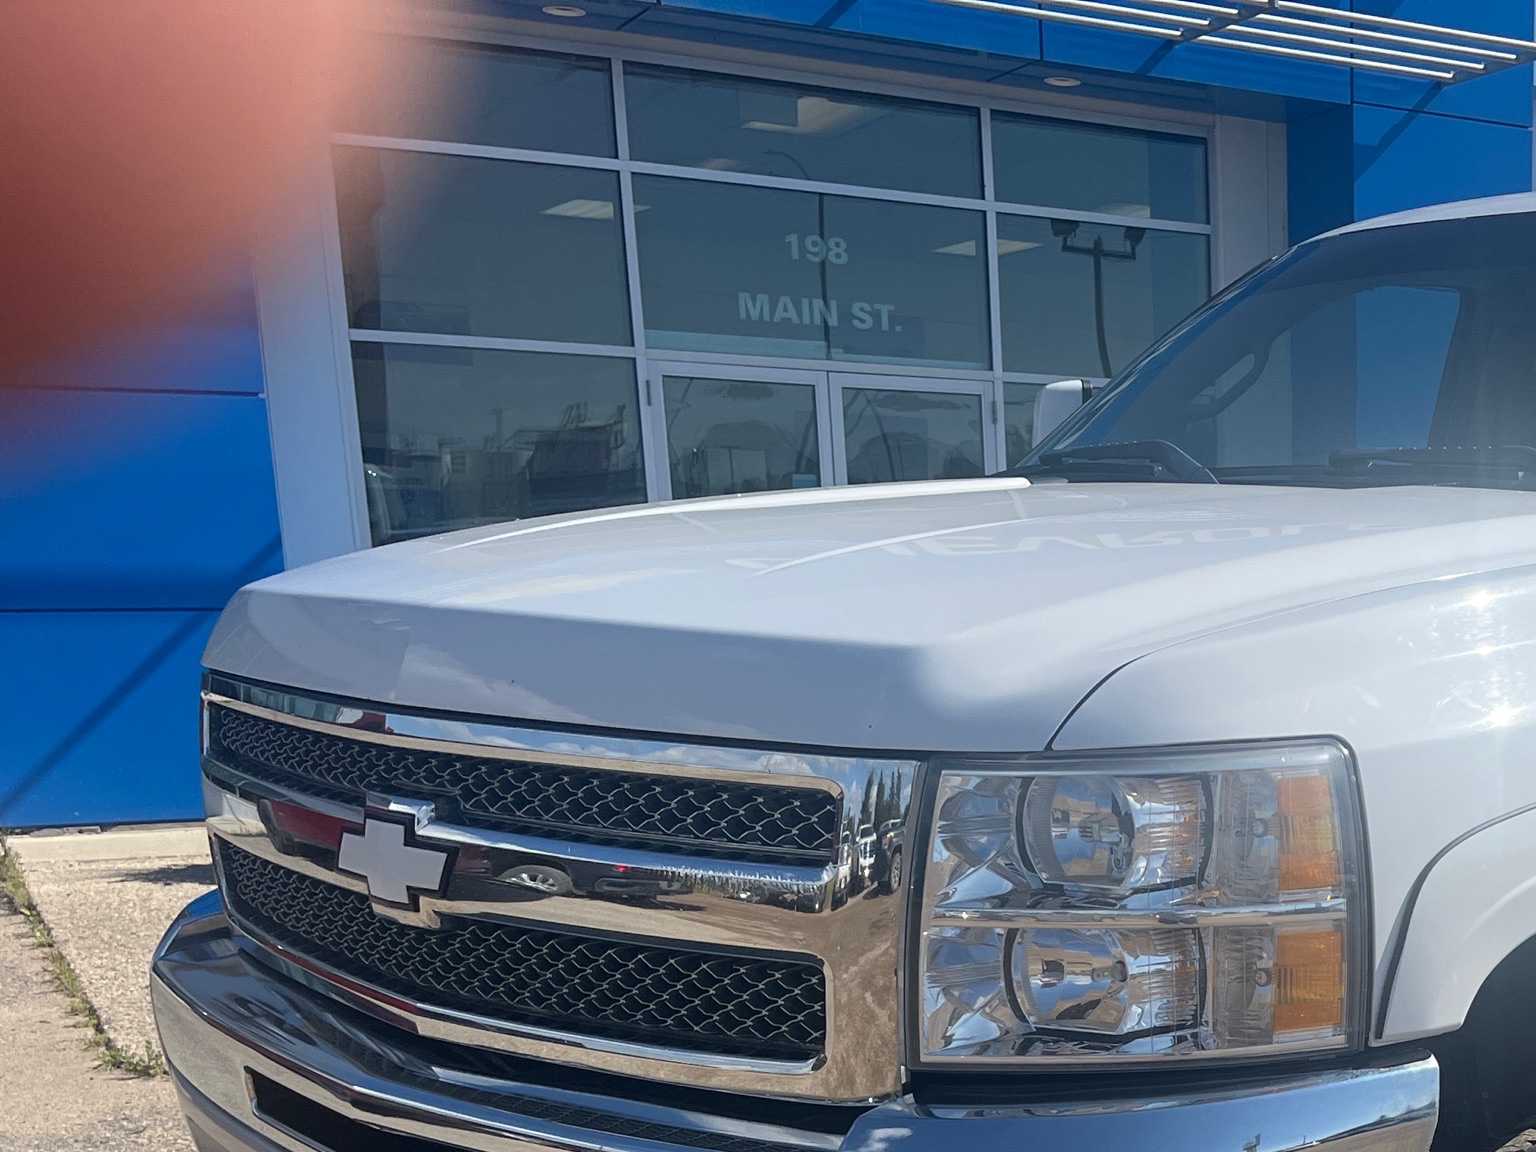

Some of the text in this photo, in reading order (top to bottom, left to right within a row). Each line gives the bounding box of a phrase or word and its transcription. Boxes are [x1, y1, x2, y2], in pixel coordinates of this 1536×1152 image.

[785, 233, 848, 264] 198
[738, 291, 903, 332] MAIN ST.
